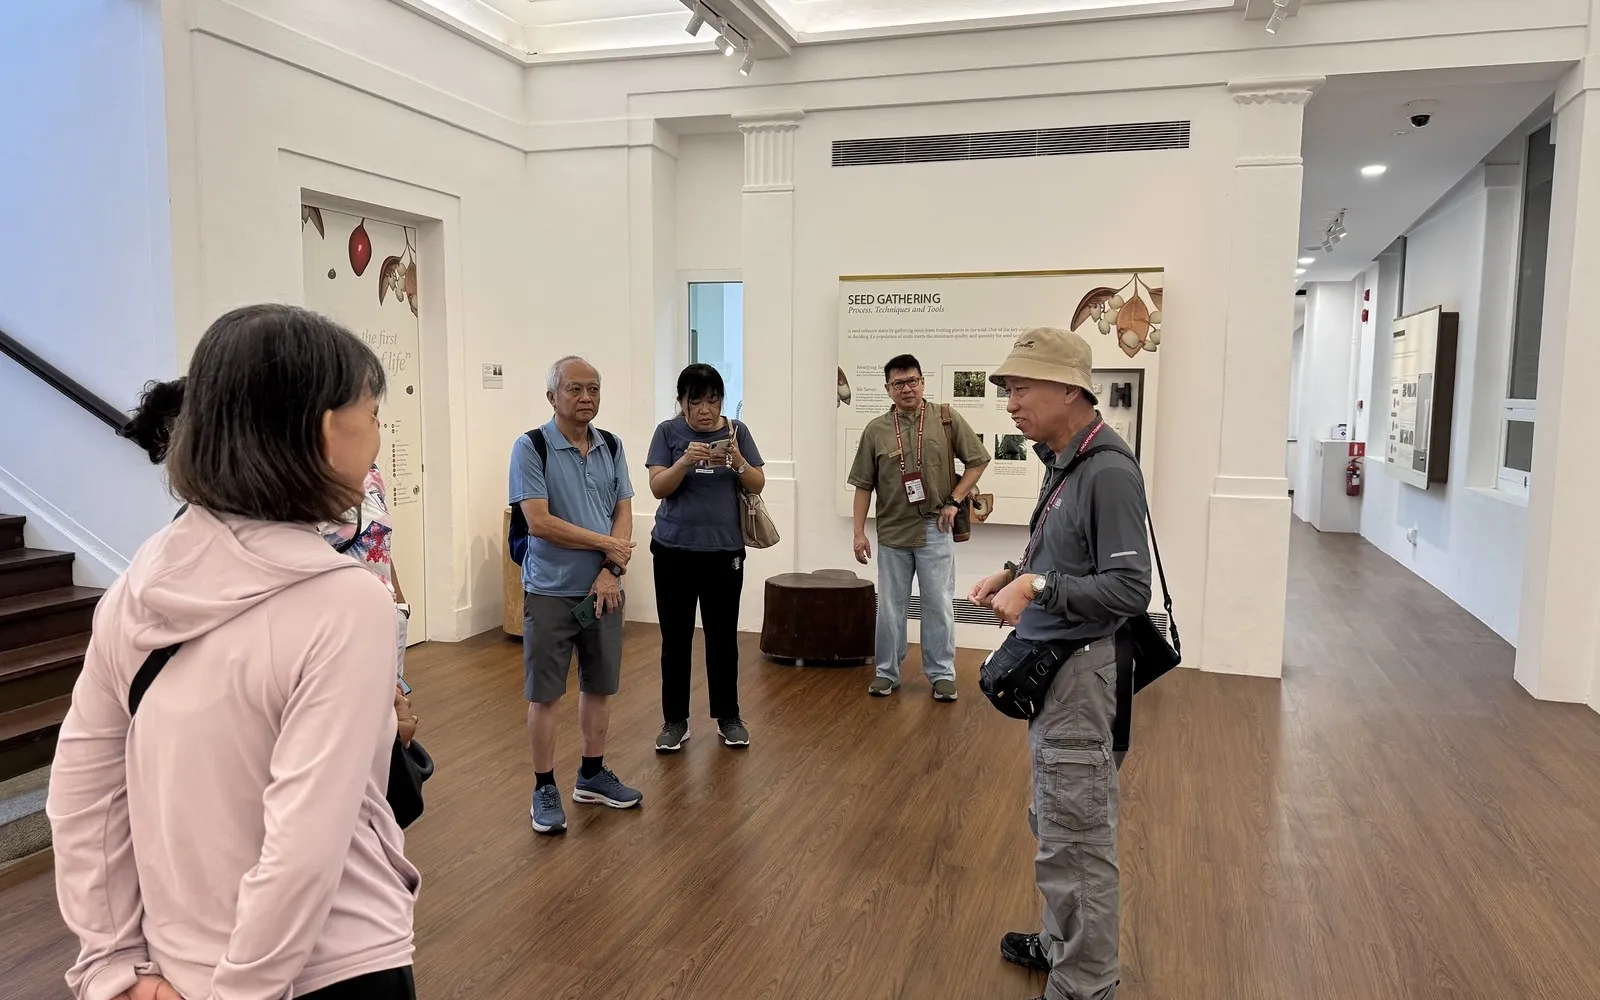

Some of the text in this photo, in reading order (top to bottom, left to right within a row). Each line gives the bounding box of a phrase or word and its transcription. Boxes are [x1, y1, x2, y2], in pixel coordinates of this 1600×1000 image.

[848, 293, 941, 304] SEED GATHERING
[848, 304, 945, 315] Process, Techniques and Tools
[377, 329, 397, 349] first
